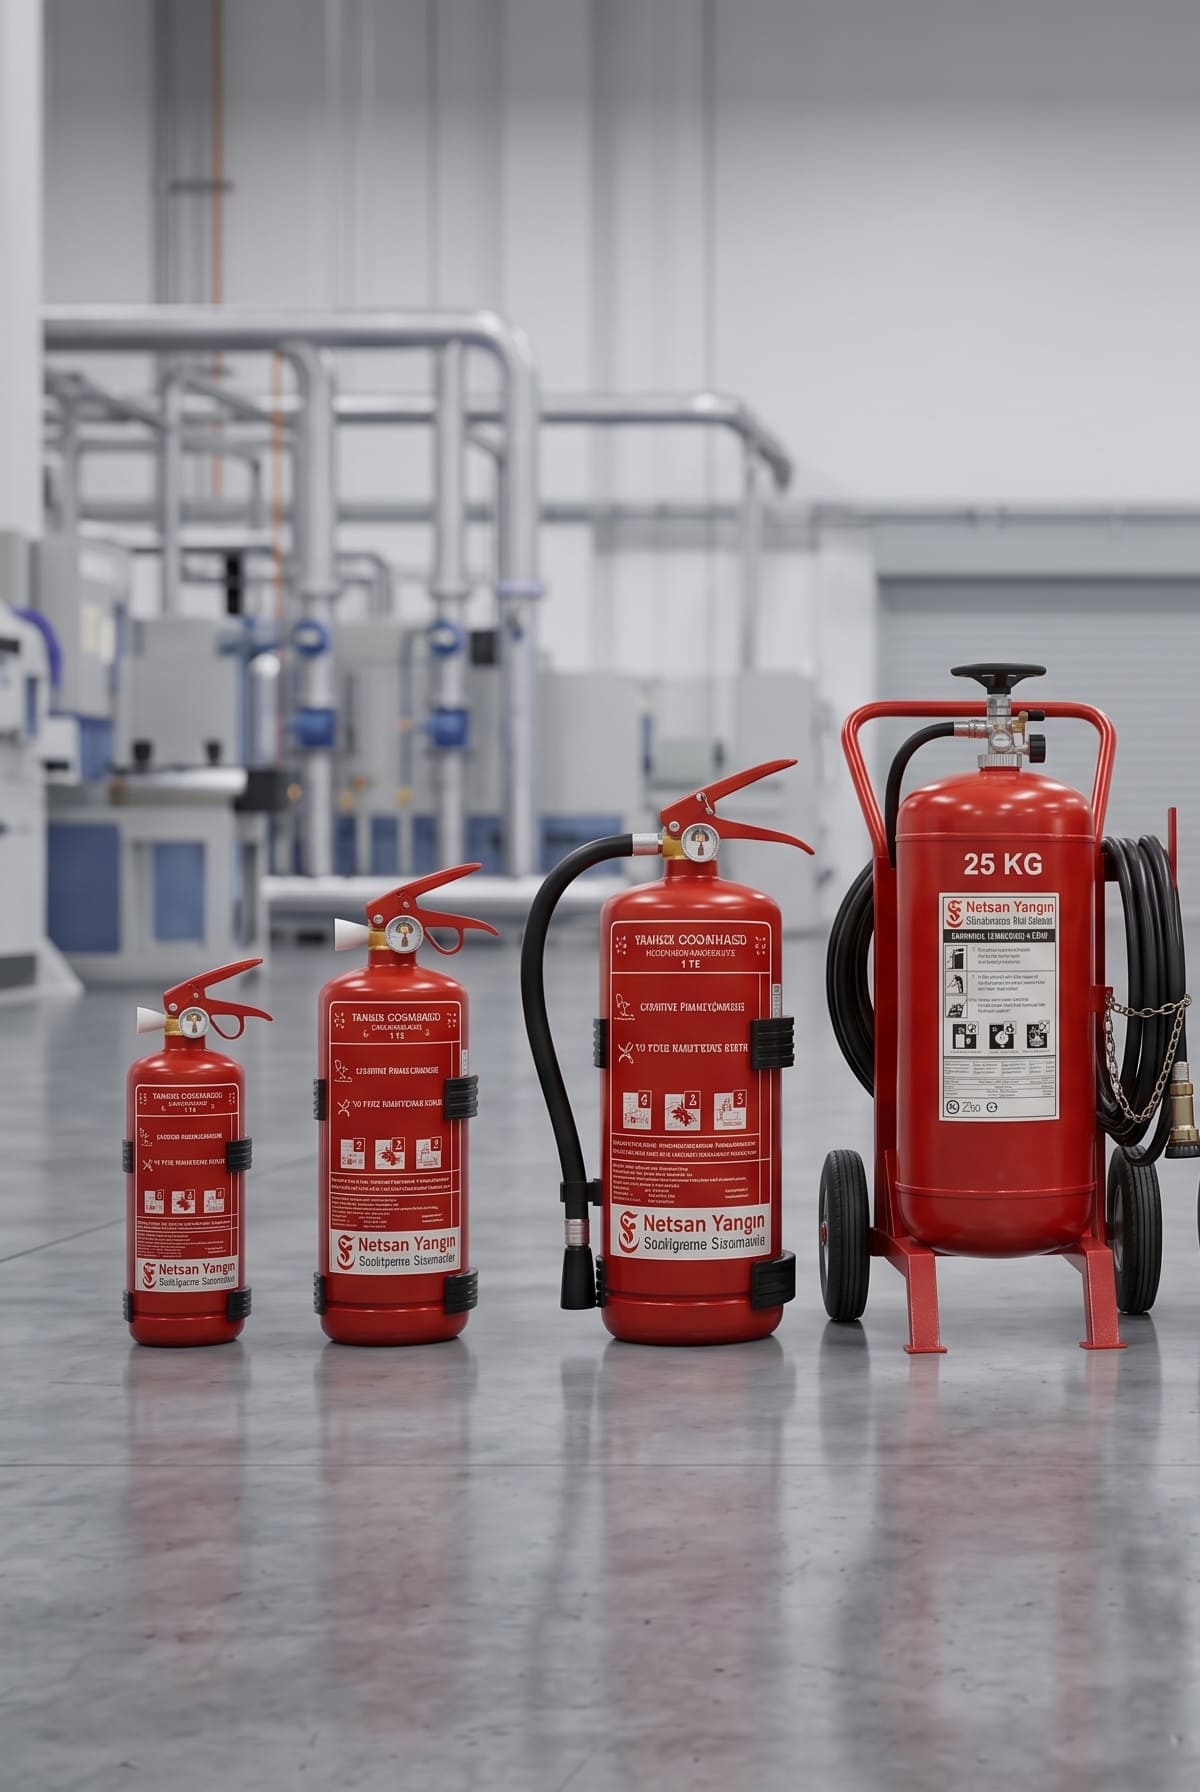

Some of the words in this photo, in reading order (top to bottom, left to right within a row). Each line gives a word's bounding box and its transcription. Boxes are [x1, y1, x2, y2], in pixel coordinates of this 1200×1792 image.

[964, 852, 995, 875] 25
[1004, 852, 1042, 876] KG
[966, 901, 1010, 913] Netsan
[1013, 901, 1054, 915] Yangın
[644, 1214, 706, 1233] Netsan
[712, 1214, 765, 1235] Yangın
[359, 1237, 409, 1252] Netsan
[414, 1235, 456, 1253] Yangın
[159, 1263, 199, 1275] Netsan
